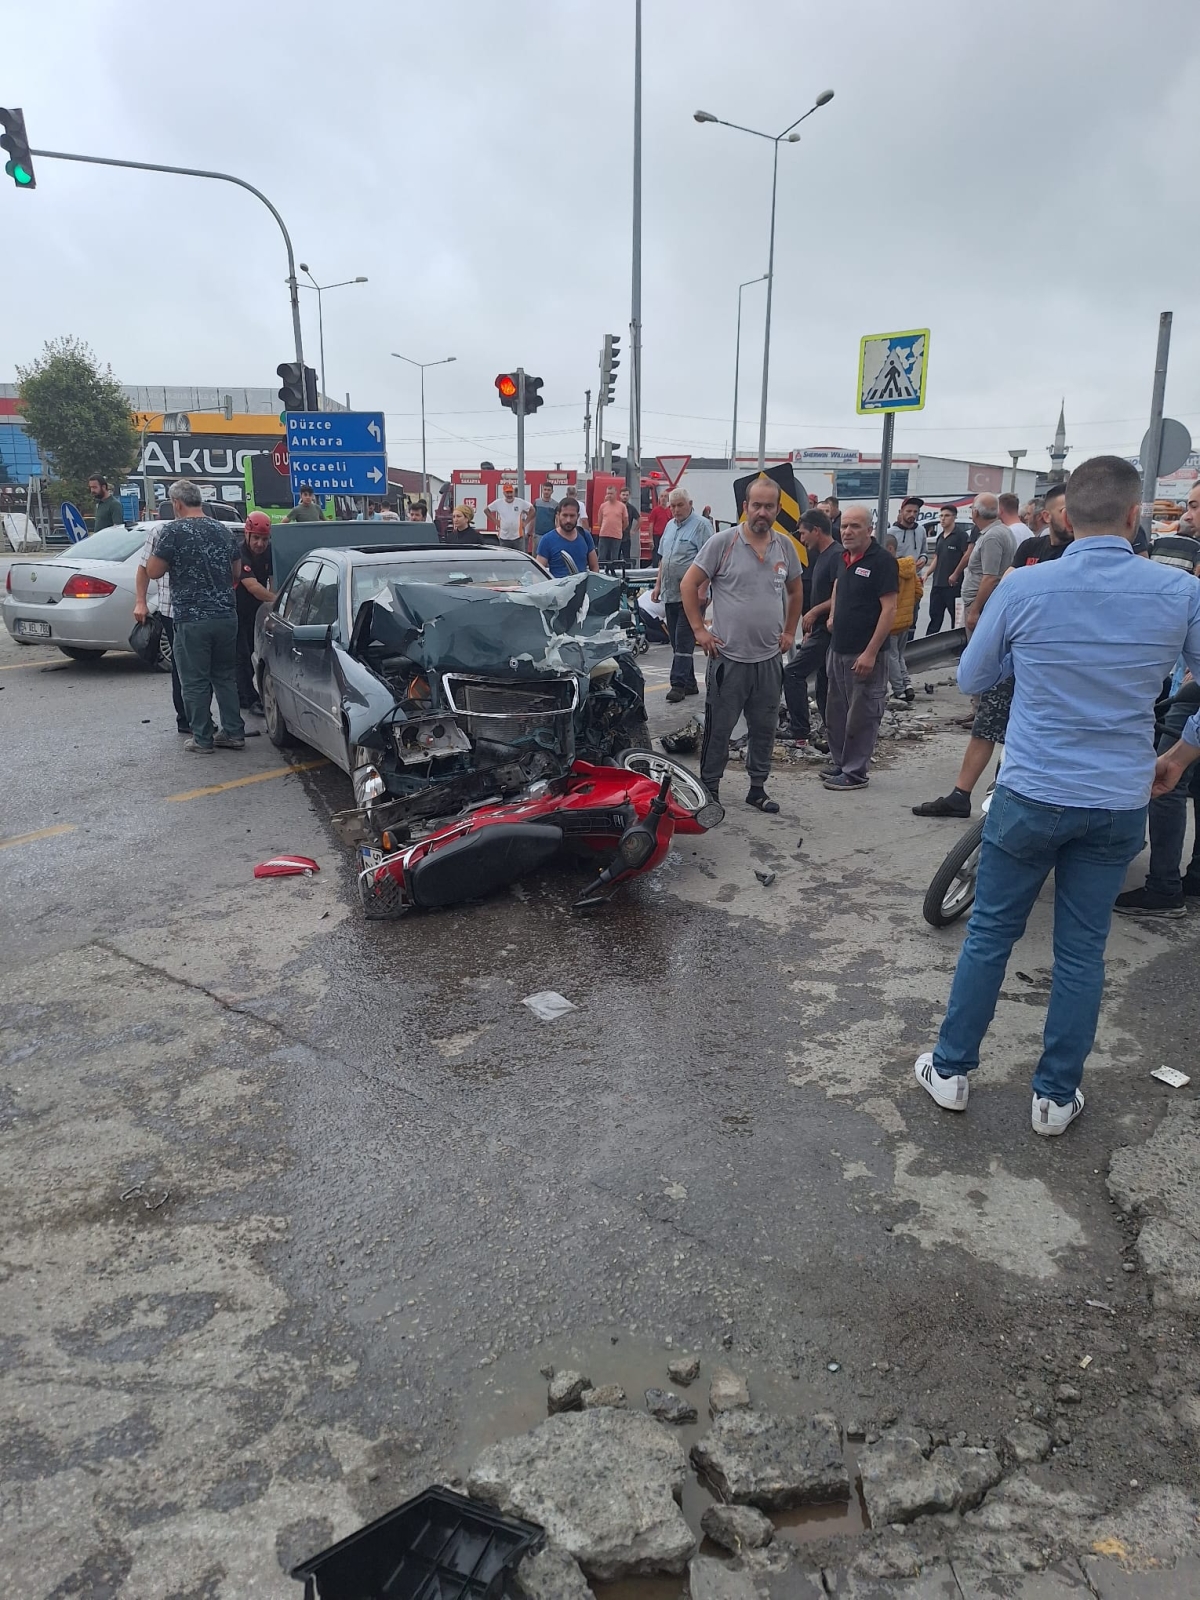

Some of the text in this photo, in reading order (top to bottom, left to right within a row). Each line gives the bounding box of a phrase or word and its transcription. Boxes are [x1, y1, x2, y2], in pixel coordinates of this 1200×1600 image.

[289, 418, 332, 430] Düzce
[291, 435, 343, 446] Ankara
[274, 452, 290, 466] DU
[292, 461, 347, 472] Kocaeli
[465, 499, 475, 508] 112
